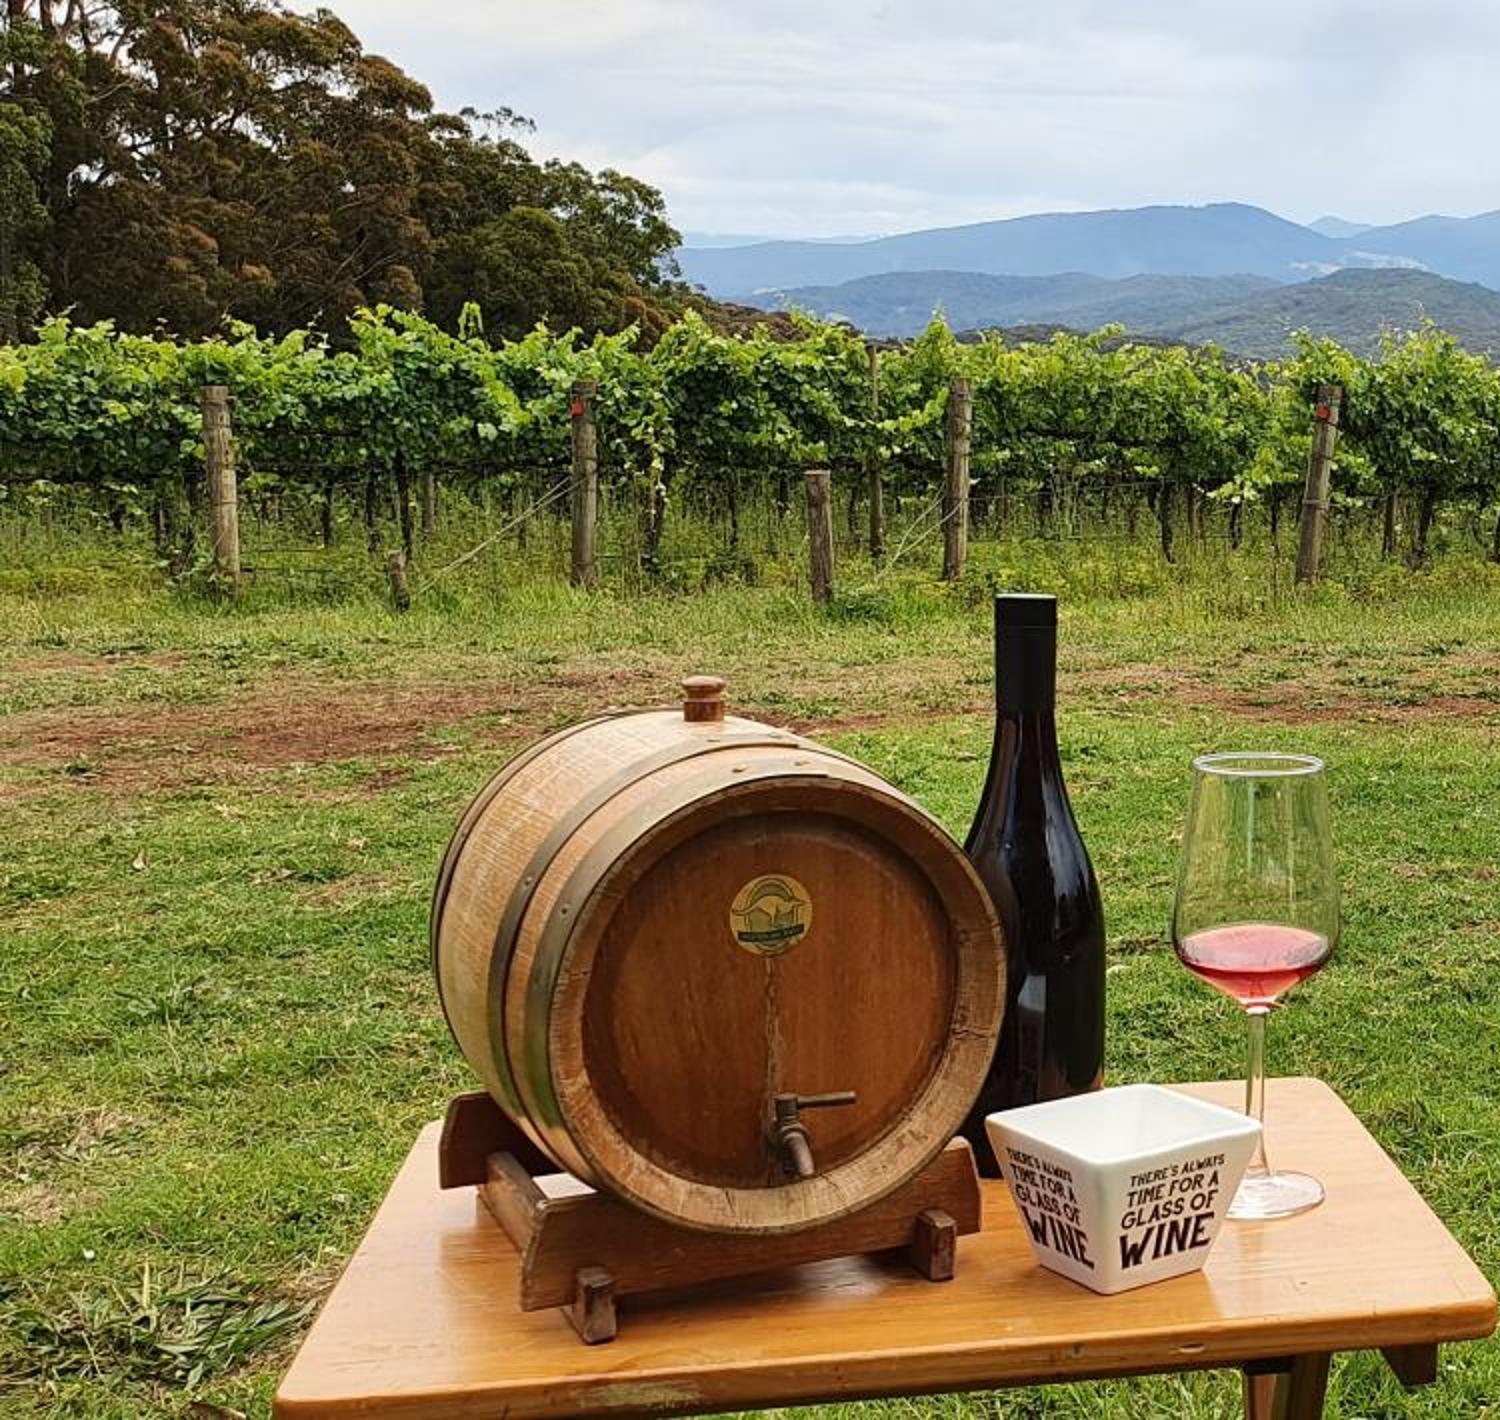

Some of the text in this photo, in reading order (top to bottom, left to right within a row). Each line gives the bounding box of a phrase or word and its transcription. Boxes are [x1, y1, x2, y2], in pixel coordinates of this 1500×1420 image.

[1009, 1163, 1078, 1205] TIME FOR A
[1127, 1169, 1219, 1209] TIME FOR A
[1130, 1153, 1225, 1188] THERE'S ALWAYS
[1015, 1183, 1080, 1227] GLASS OF
[1120, 1188, 1219, 1231] GLASS OF
[1021, 1205, 1095, 1270] WINE
[1119, 1211, 1215, 1271] WINE
